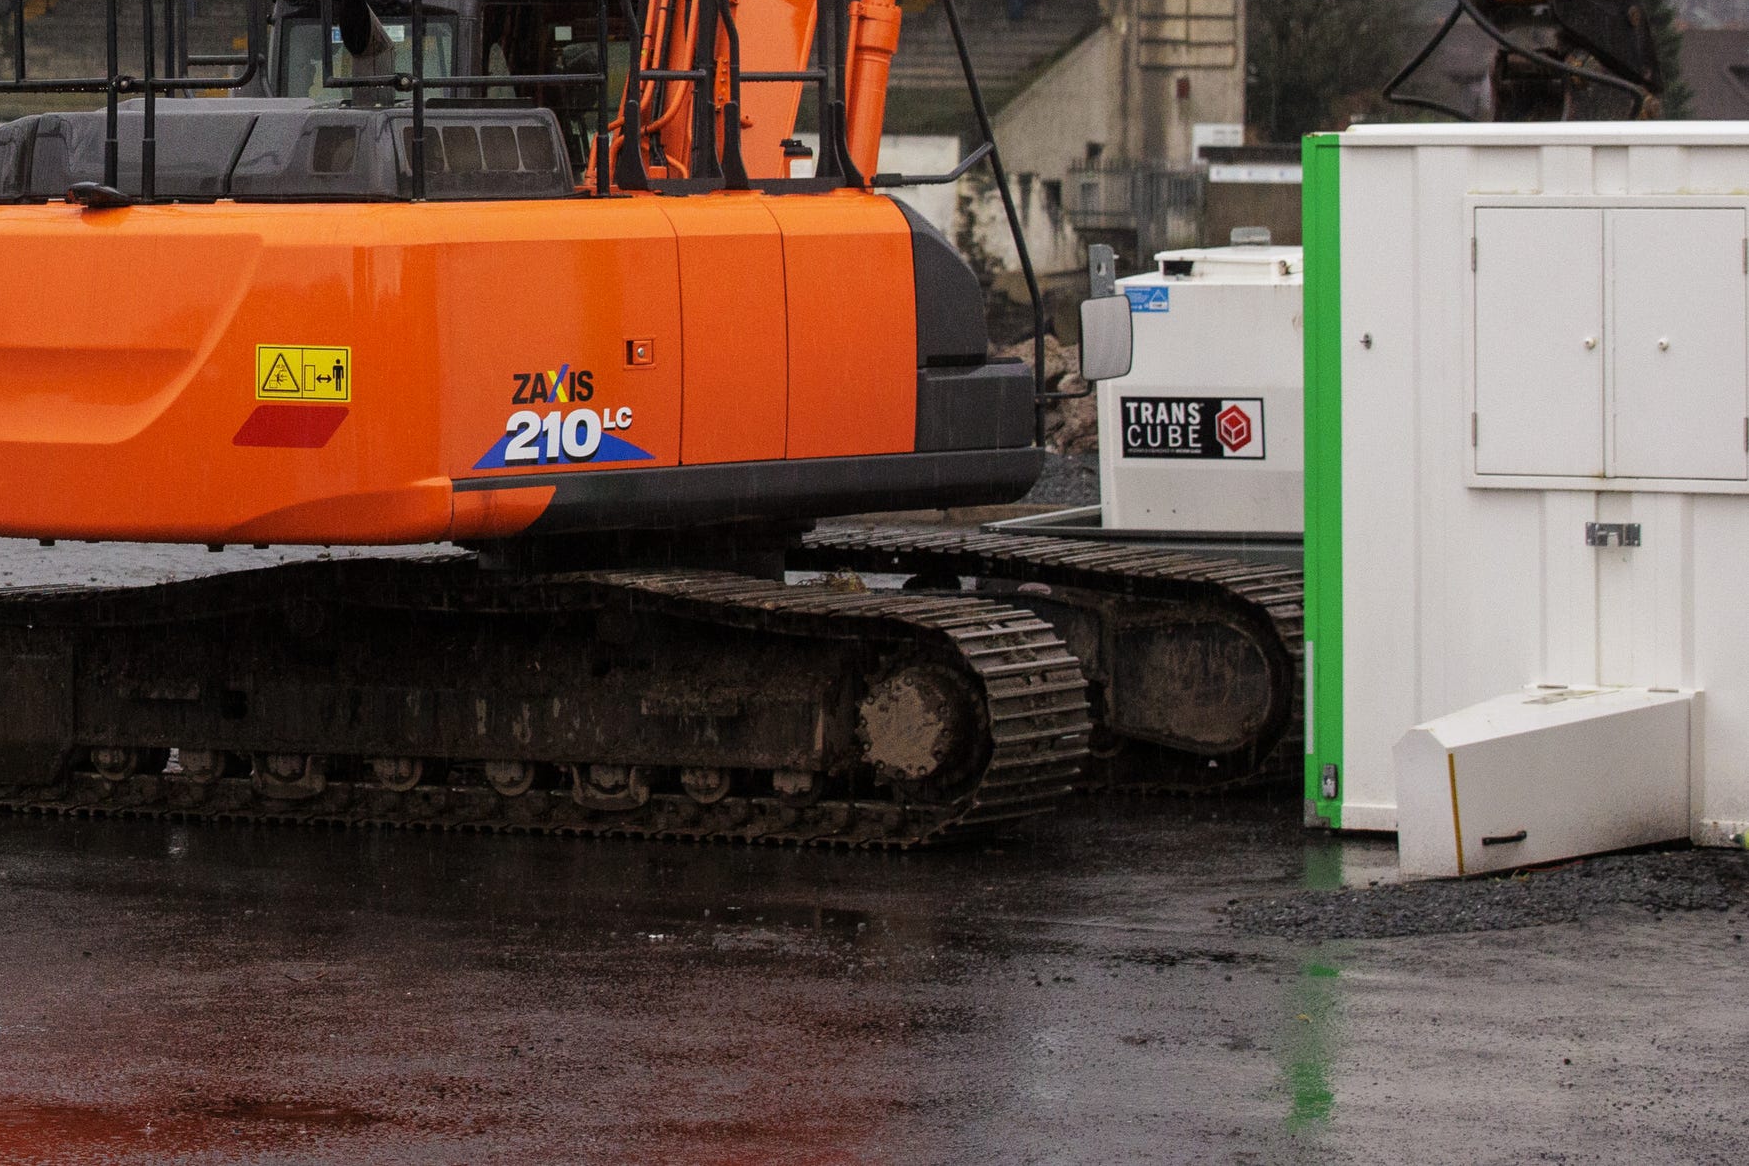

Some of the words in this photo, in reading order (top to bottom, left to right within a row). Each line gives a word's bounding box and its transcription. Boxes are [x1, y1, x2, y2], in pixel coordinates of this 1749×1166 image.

[511, 363, 594, 405] ZAXIS
[1125, 401, 1201, 424] TRANS
[1127, 424, 1202, 447] CUBE
